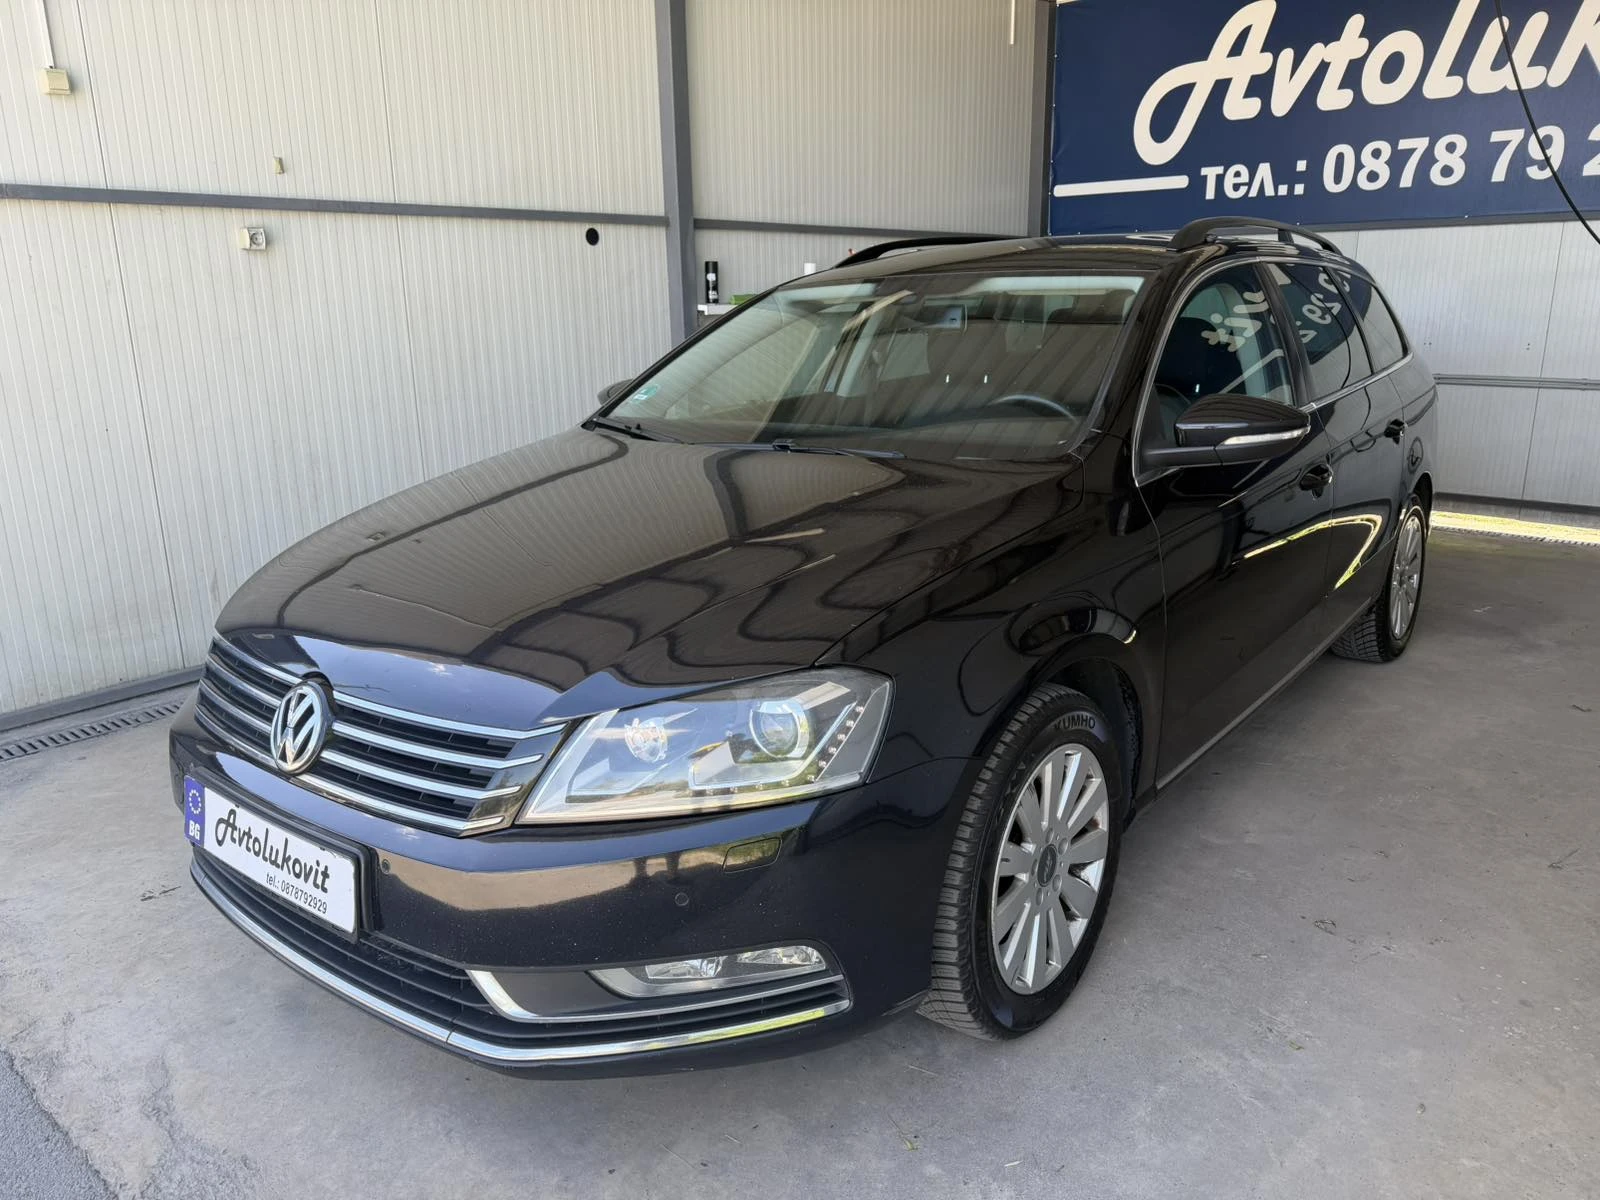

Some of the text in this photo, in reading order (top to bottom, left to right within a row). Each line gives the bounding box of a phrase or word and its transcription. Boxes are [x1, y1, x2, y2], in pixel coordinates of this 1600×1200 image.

[1200, 159, 1307, 200] тел.:
[1322, 133, 1468, 194] 0878
[1489, 125, 1565, 183] 79
[188, 820, 200, 841] BG
[215, 808, 331, 894] Avtolukovit
[280, 880, 329, 915] 0878792929
